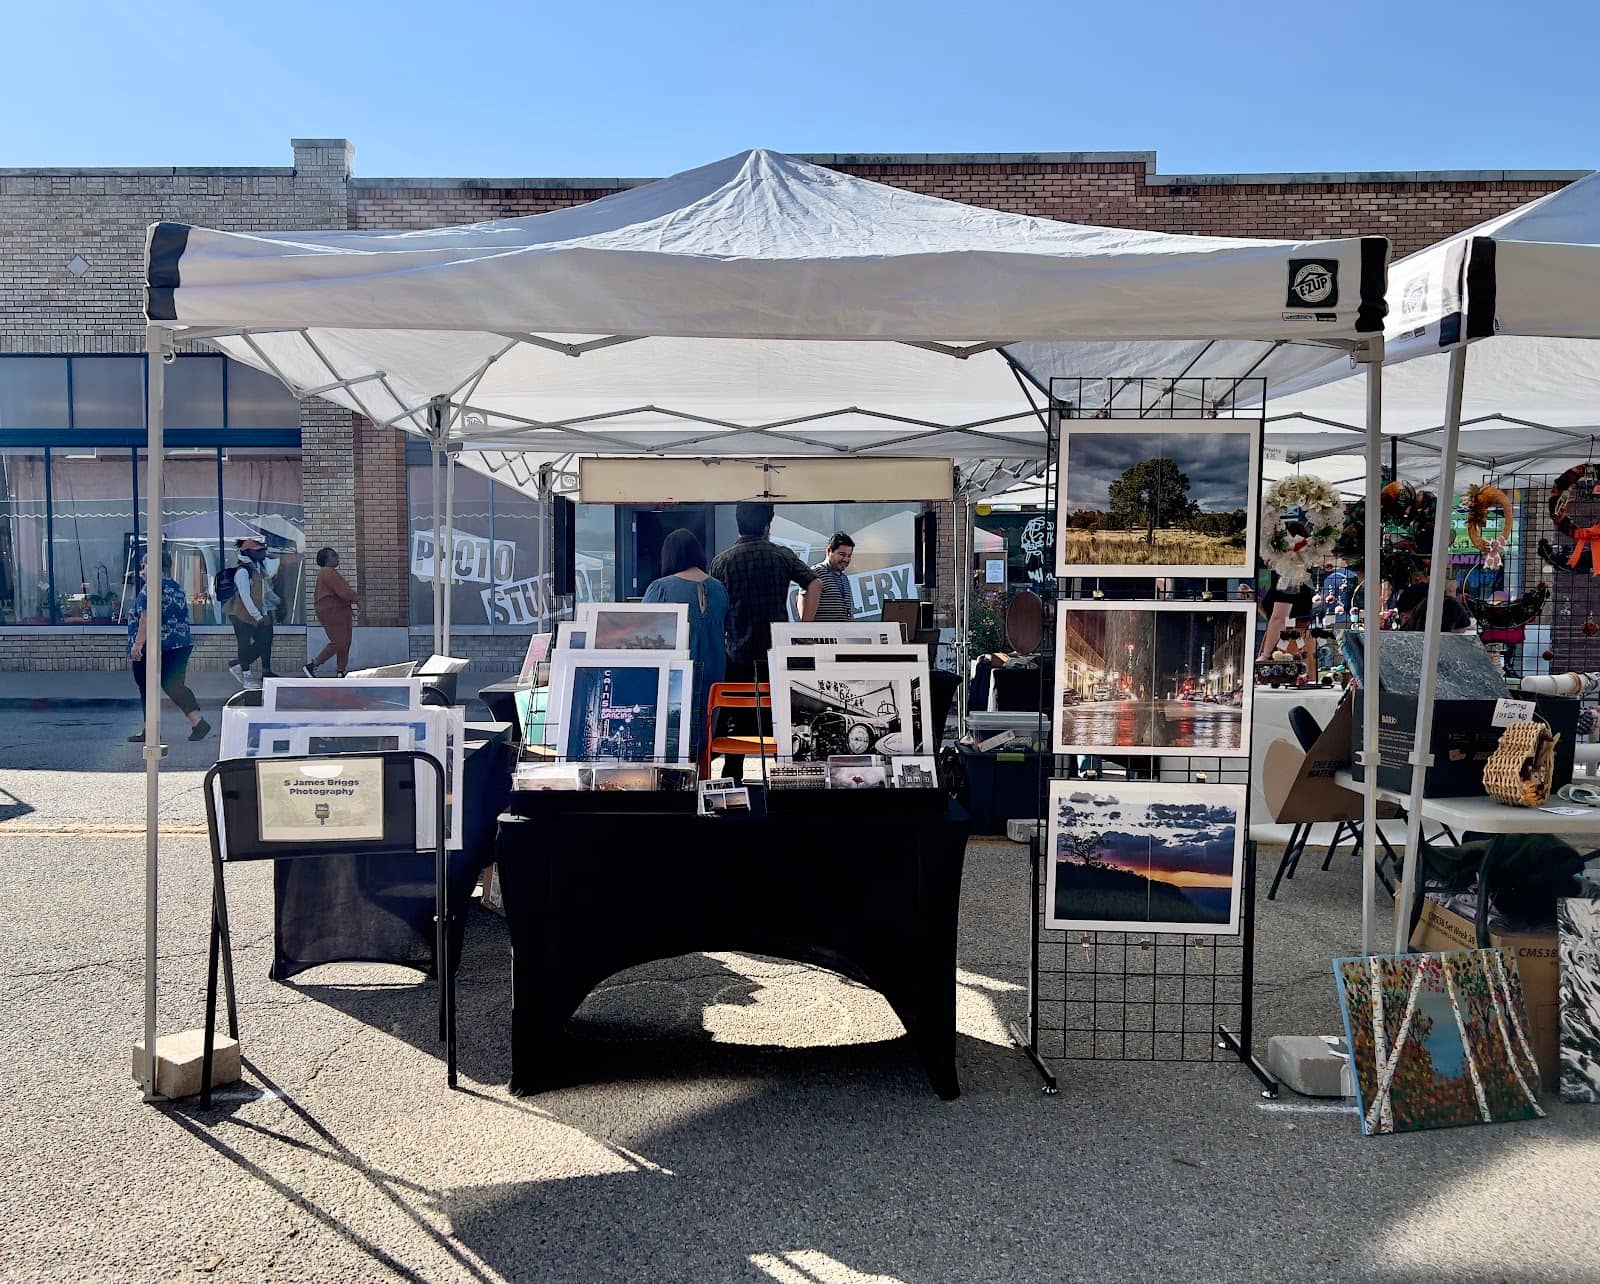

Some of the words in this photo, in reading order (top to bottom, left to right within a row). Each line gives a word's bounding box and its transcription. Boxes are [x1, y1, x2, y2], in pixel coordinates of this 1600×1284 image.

[283, 779, 291, 787] S
[327, 779, 360, 787] Briggs
[289, 788, 354, 796] Photography
[1453, 924, 1468, 940] Week
[1518, 947, 1559, 959] CMS38
